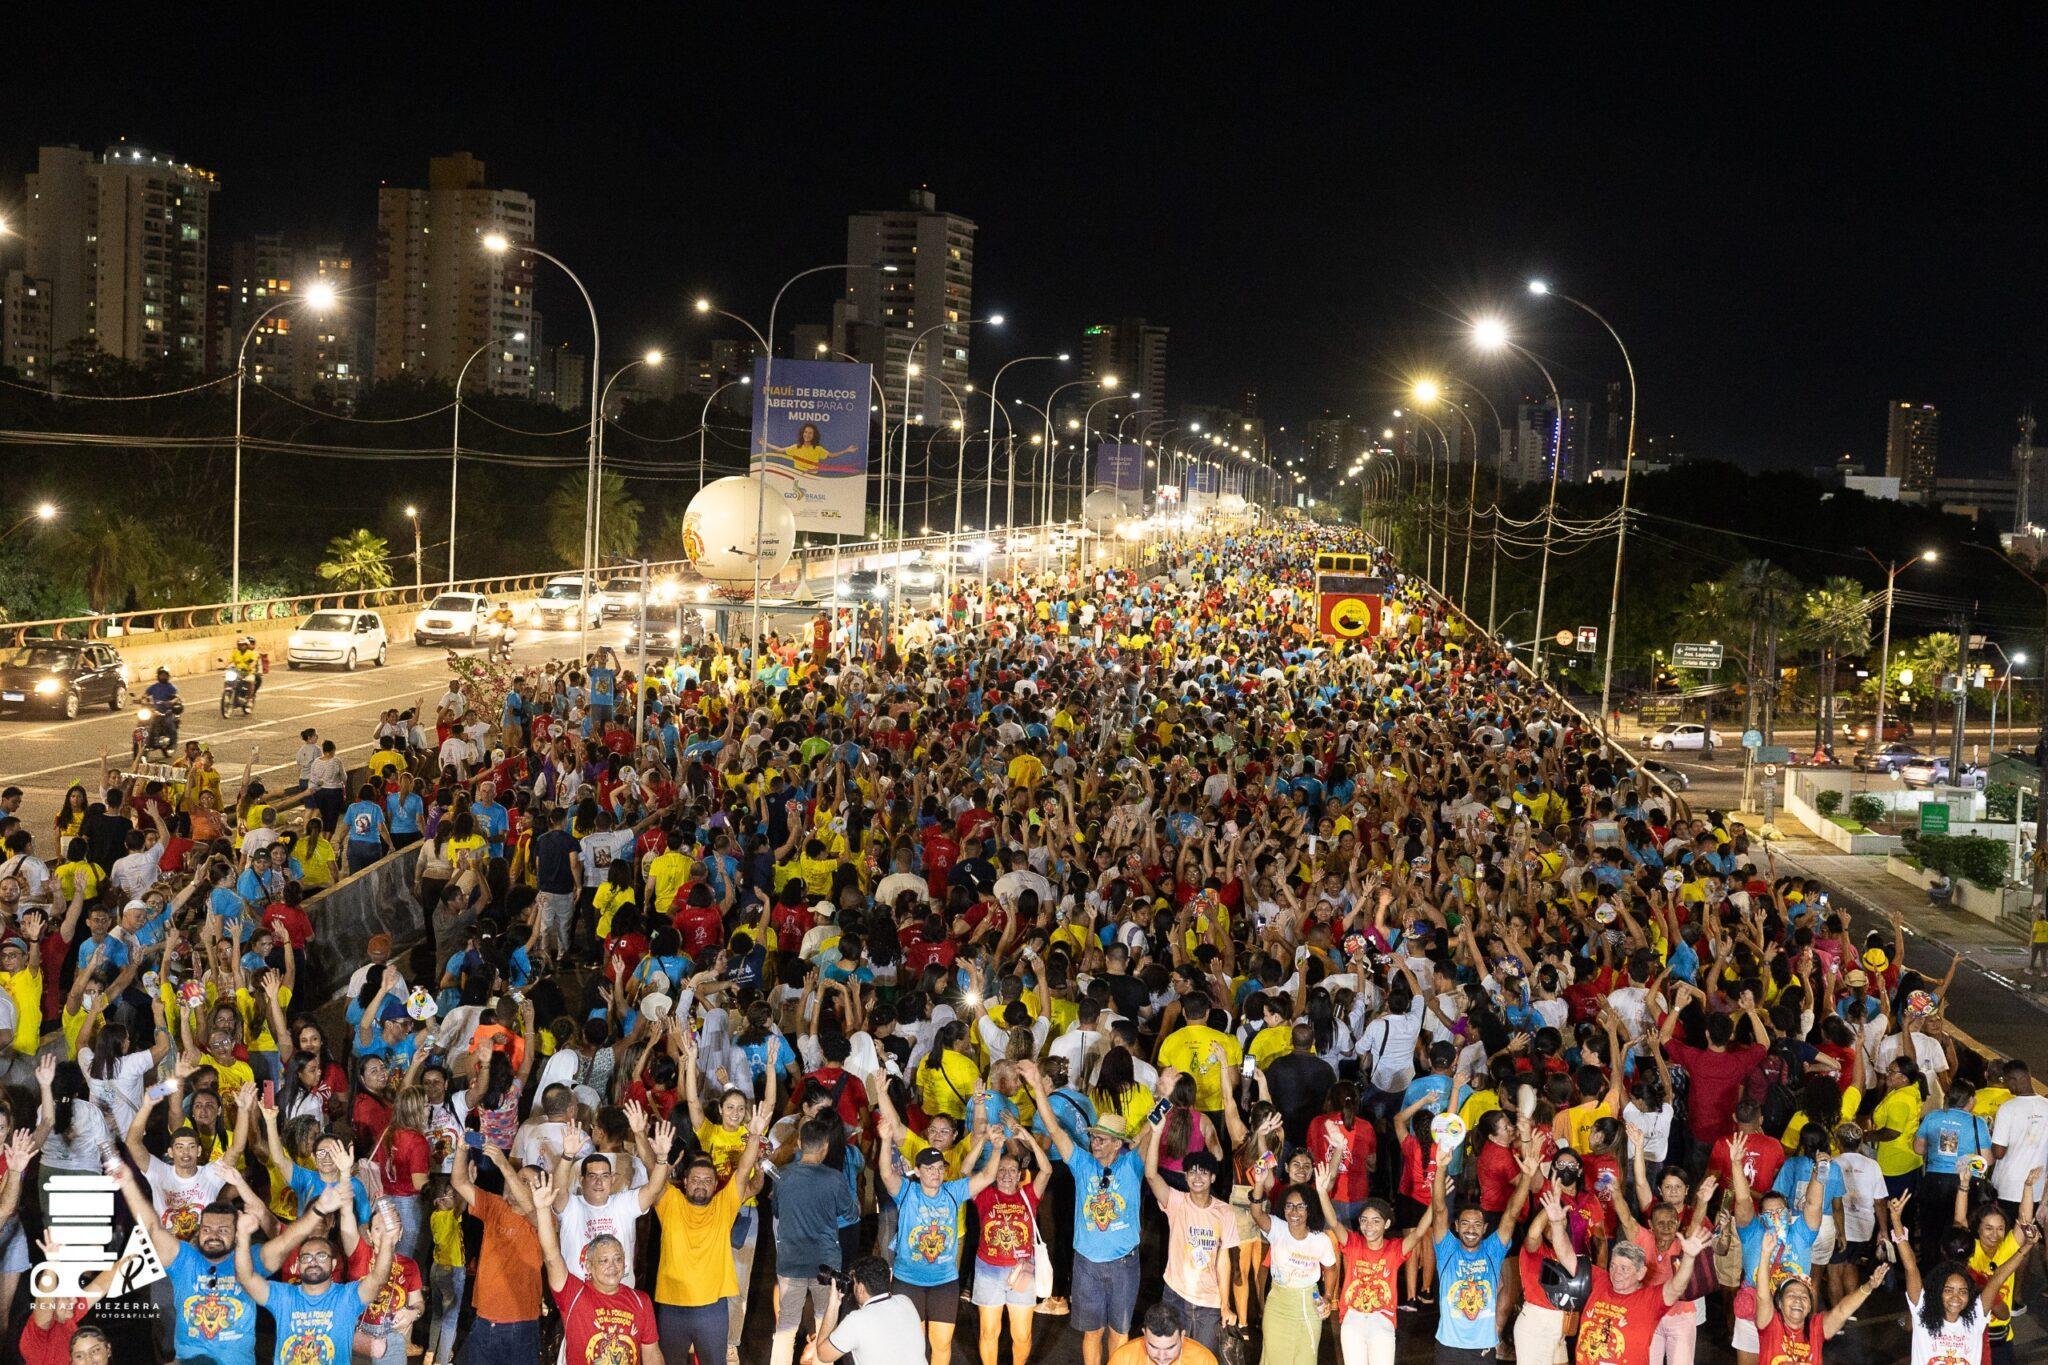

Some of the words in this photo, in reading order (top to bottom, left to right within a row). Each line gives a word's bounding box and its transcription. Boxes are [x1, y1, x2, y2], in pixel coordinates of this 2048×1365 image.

[796, 388, 810, 397] DE
[812, 388, 857, 400] BRAÇOS
[767, 398, 815, 409] ABERTOS
[816, 401, 844, 411] PARA
[845, 402, 854, 411] O
[788, 411, 830, 422] MUNDO
